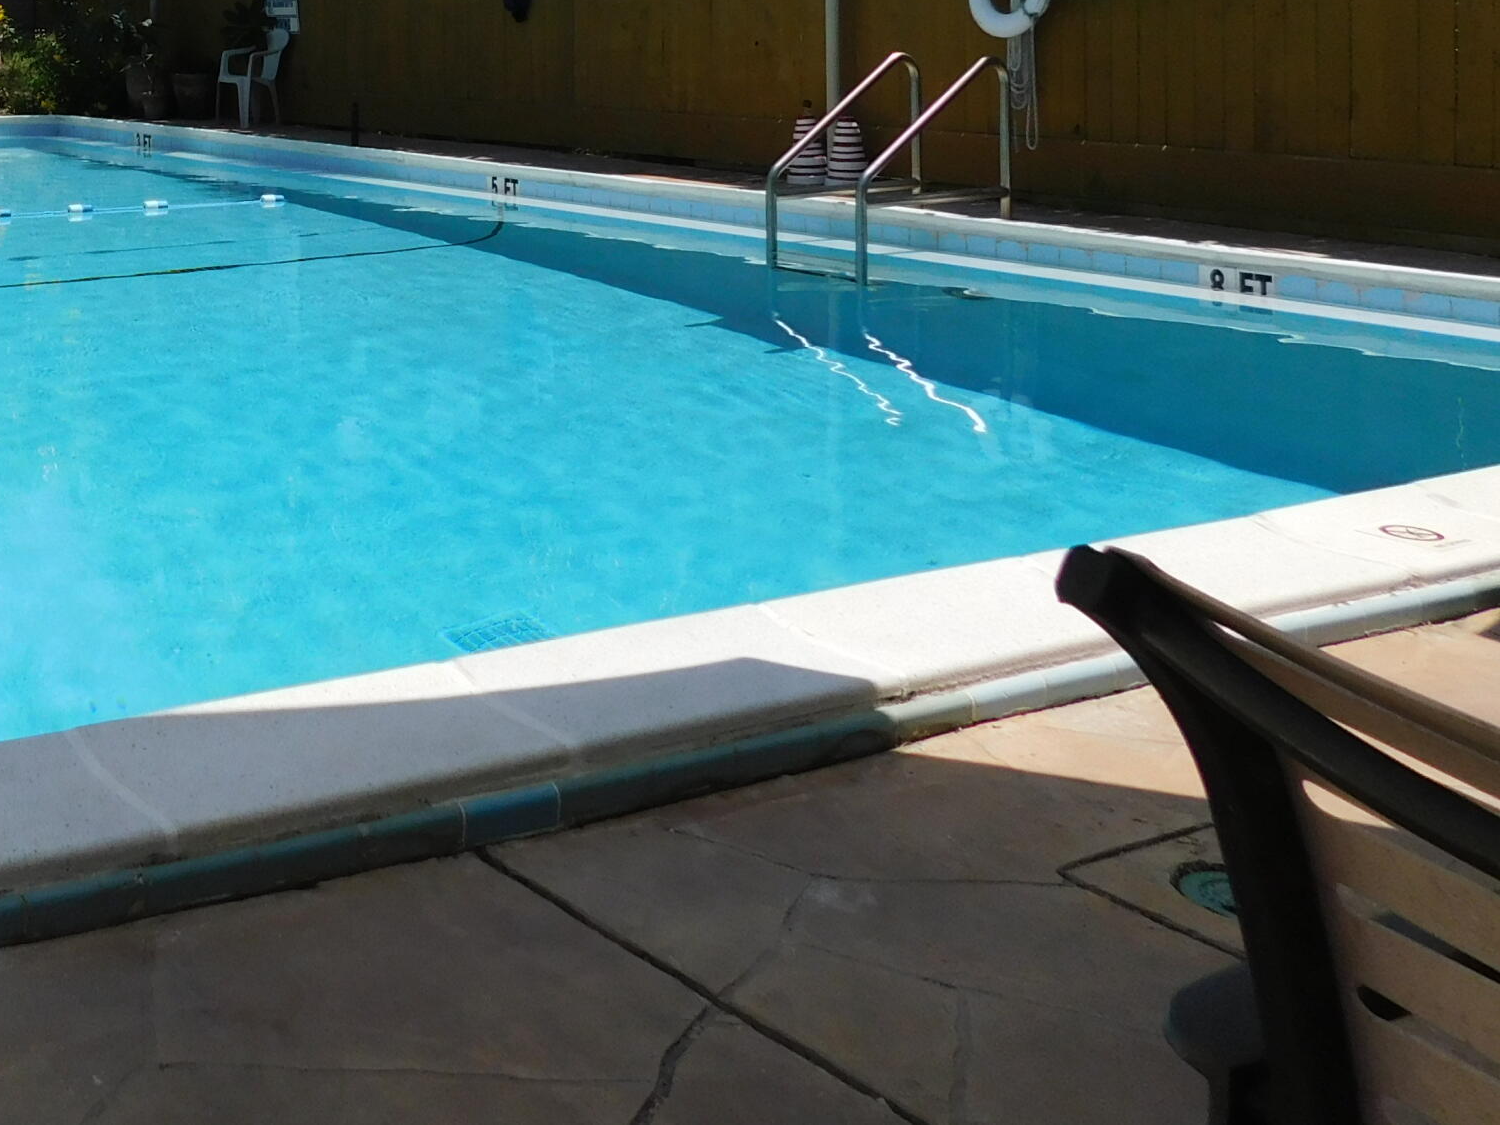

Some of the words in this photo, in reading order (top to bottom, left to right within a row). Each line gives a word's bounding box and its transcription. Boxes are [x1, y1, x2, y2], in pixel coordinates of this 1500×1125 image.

[143, 133, 152, 148] FT
[492, 176, 498, 193] 5
[504, 178, 518, 196] FT
[1239, 272, 1272, 295] FT
